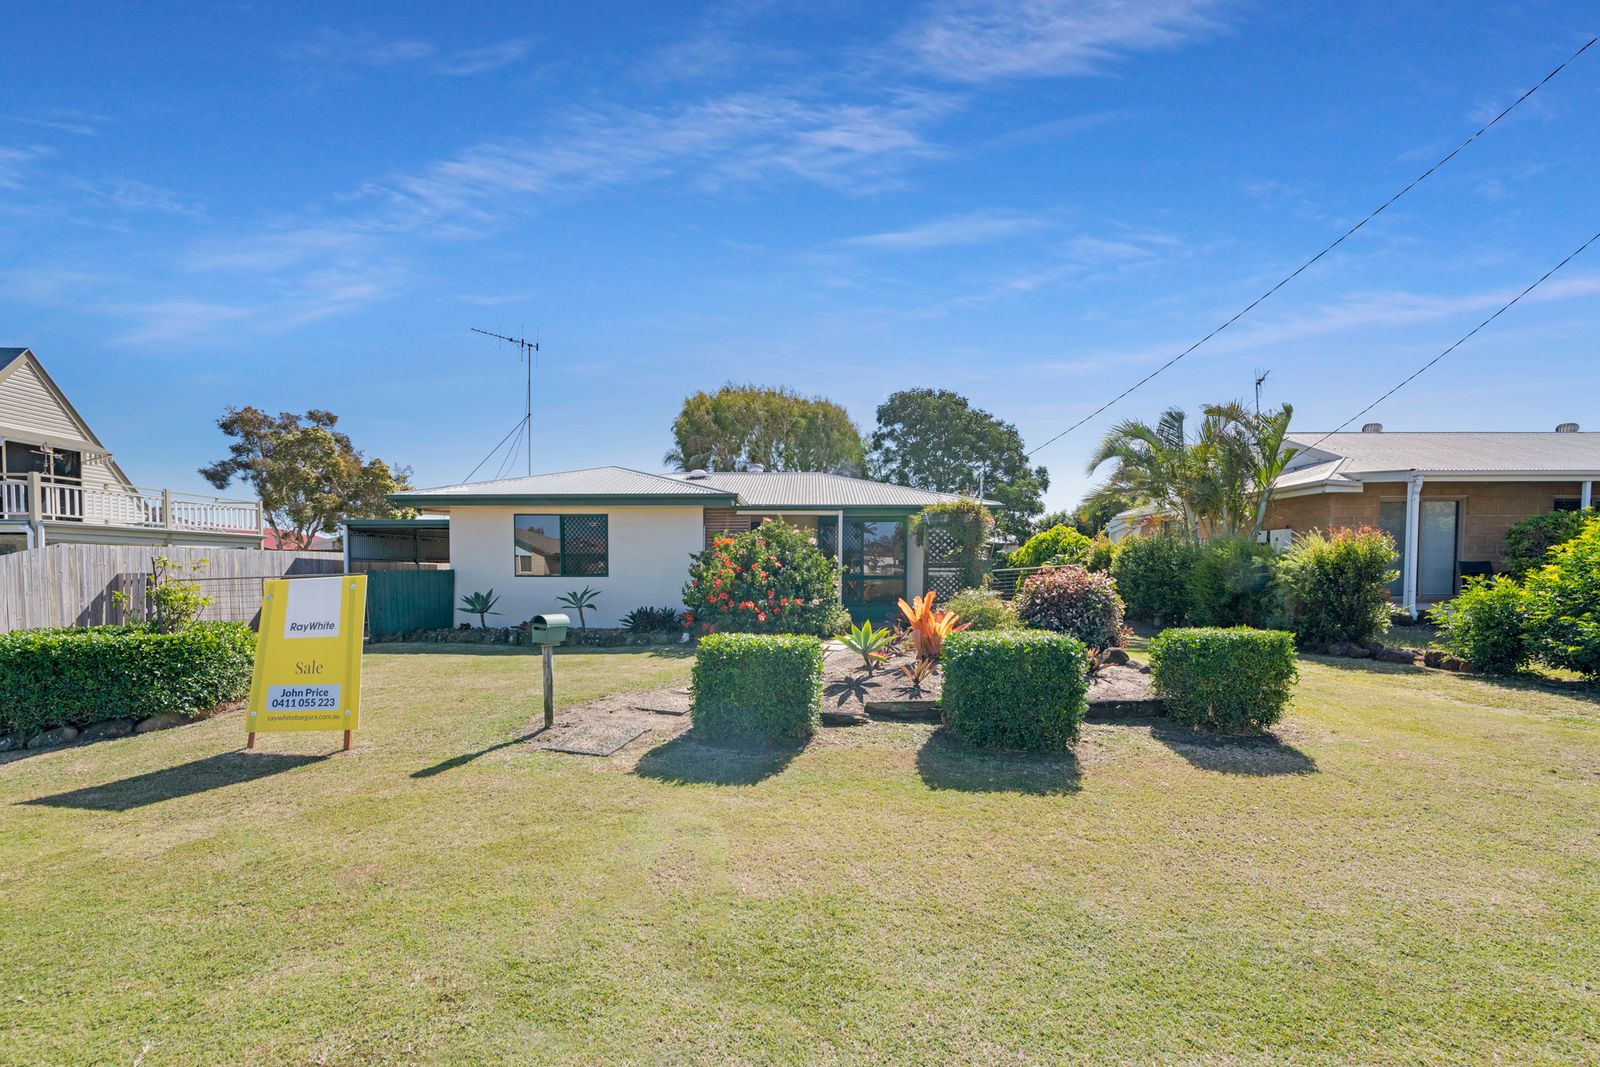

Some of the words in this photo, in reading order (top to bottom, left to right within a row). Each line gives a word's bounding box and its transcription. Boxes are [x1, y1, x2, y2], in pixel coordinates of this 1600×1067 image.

[295, 660, 323, 675] Sale
[280, 688, 304, 697] John
[305, 687, 329, 697] Price
[271, 698, 296, 708] 0411
[298, 698, 316, 707] 055
[317, 698, 335, 707] 223
[267, 714, 340, 722] raywhitebargara.com.au
